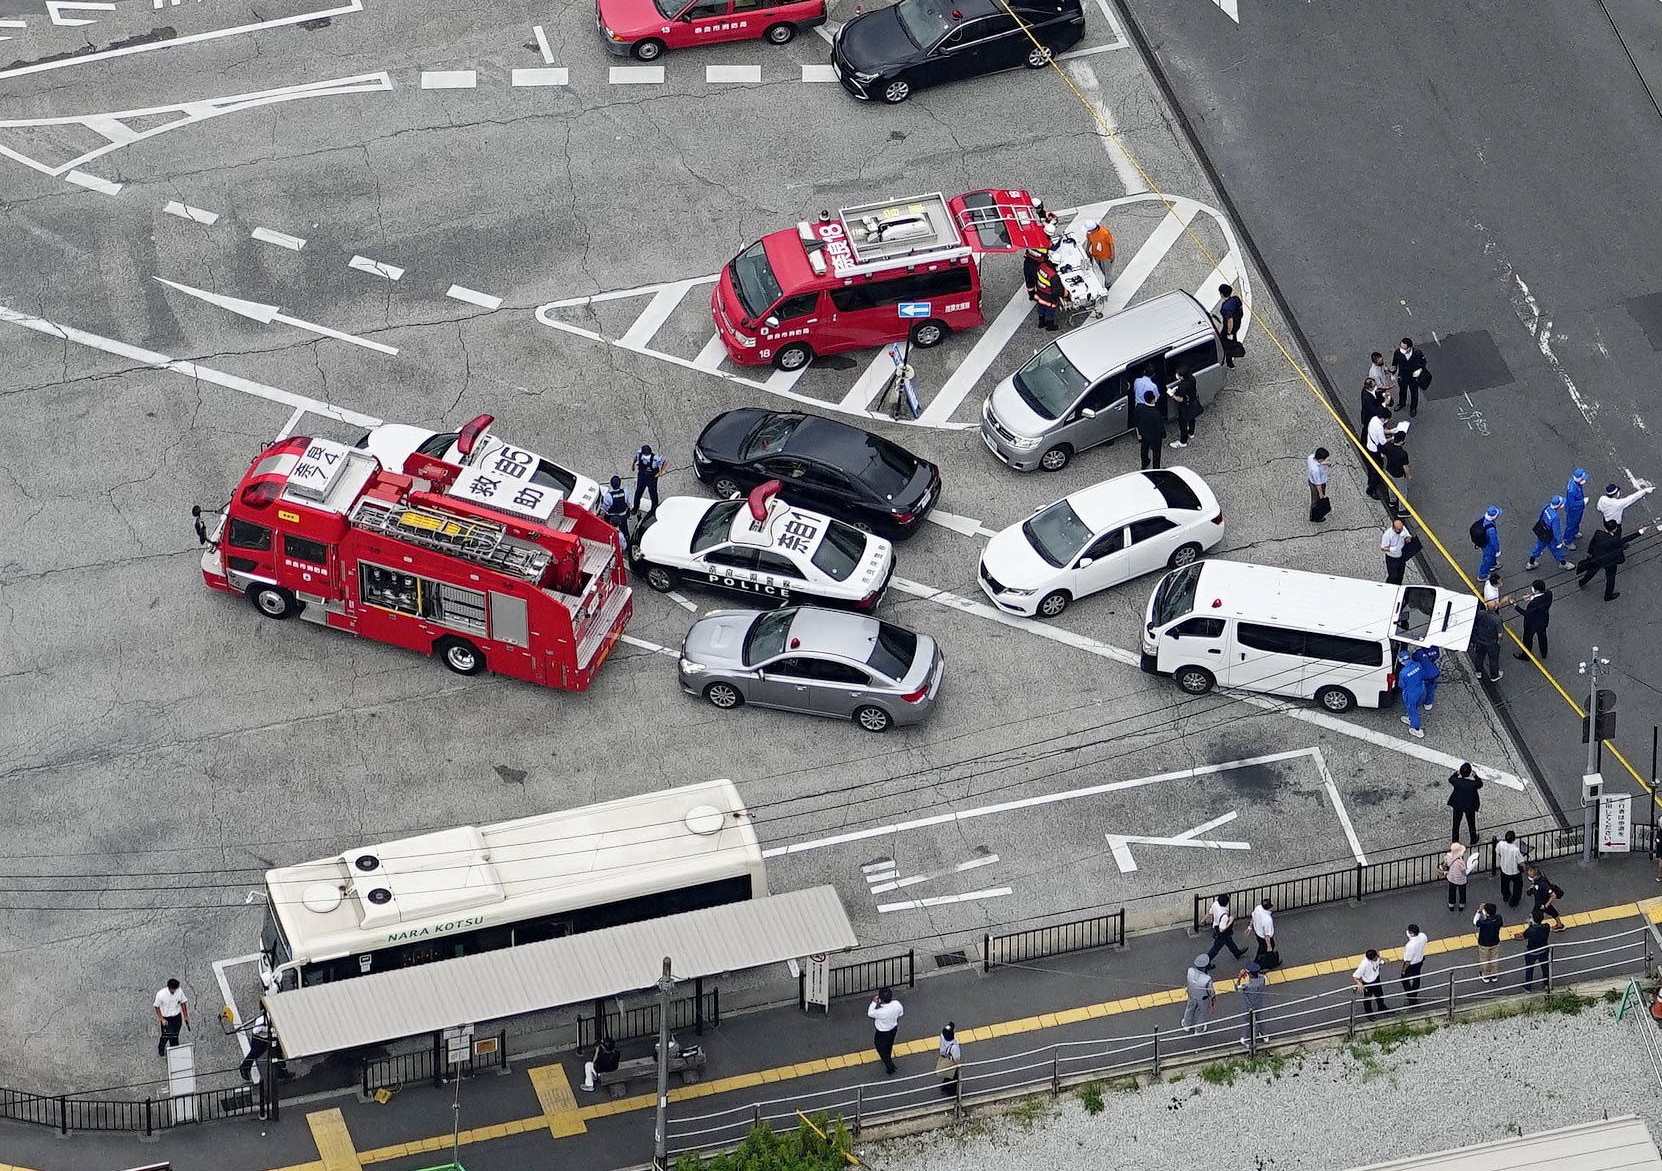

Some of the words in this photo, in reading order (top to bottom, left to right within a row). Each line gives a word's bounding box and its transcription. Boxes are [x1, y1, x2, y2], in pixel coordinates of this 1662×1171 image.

[759, 349, 771, 359] 18
[294, 445, 327, 479] 奈良
[310, 452, 340, 480] 74
[469, 475, 545, 510] 救助
[708, 574, 791, 598] POLICE
[387, 927, 430, 942] NARA
[434, 916, 485, 933] KOTSU
